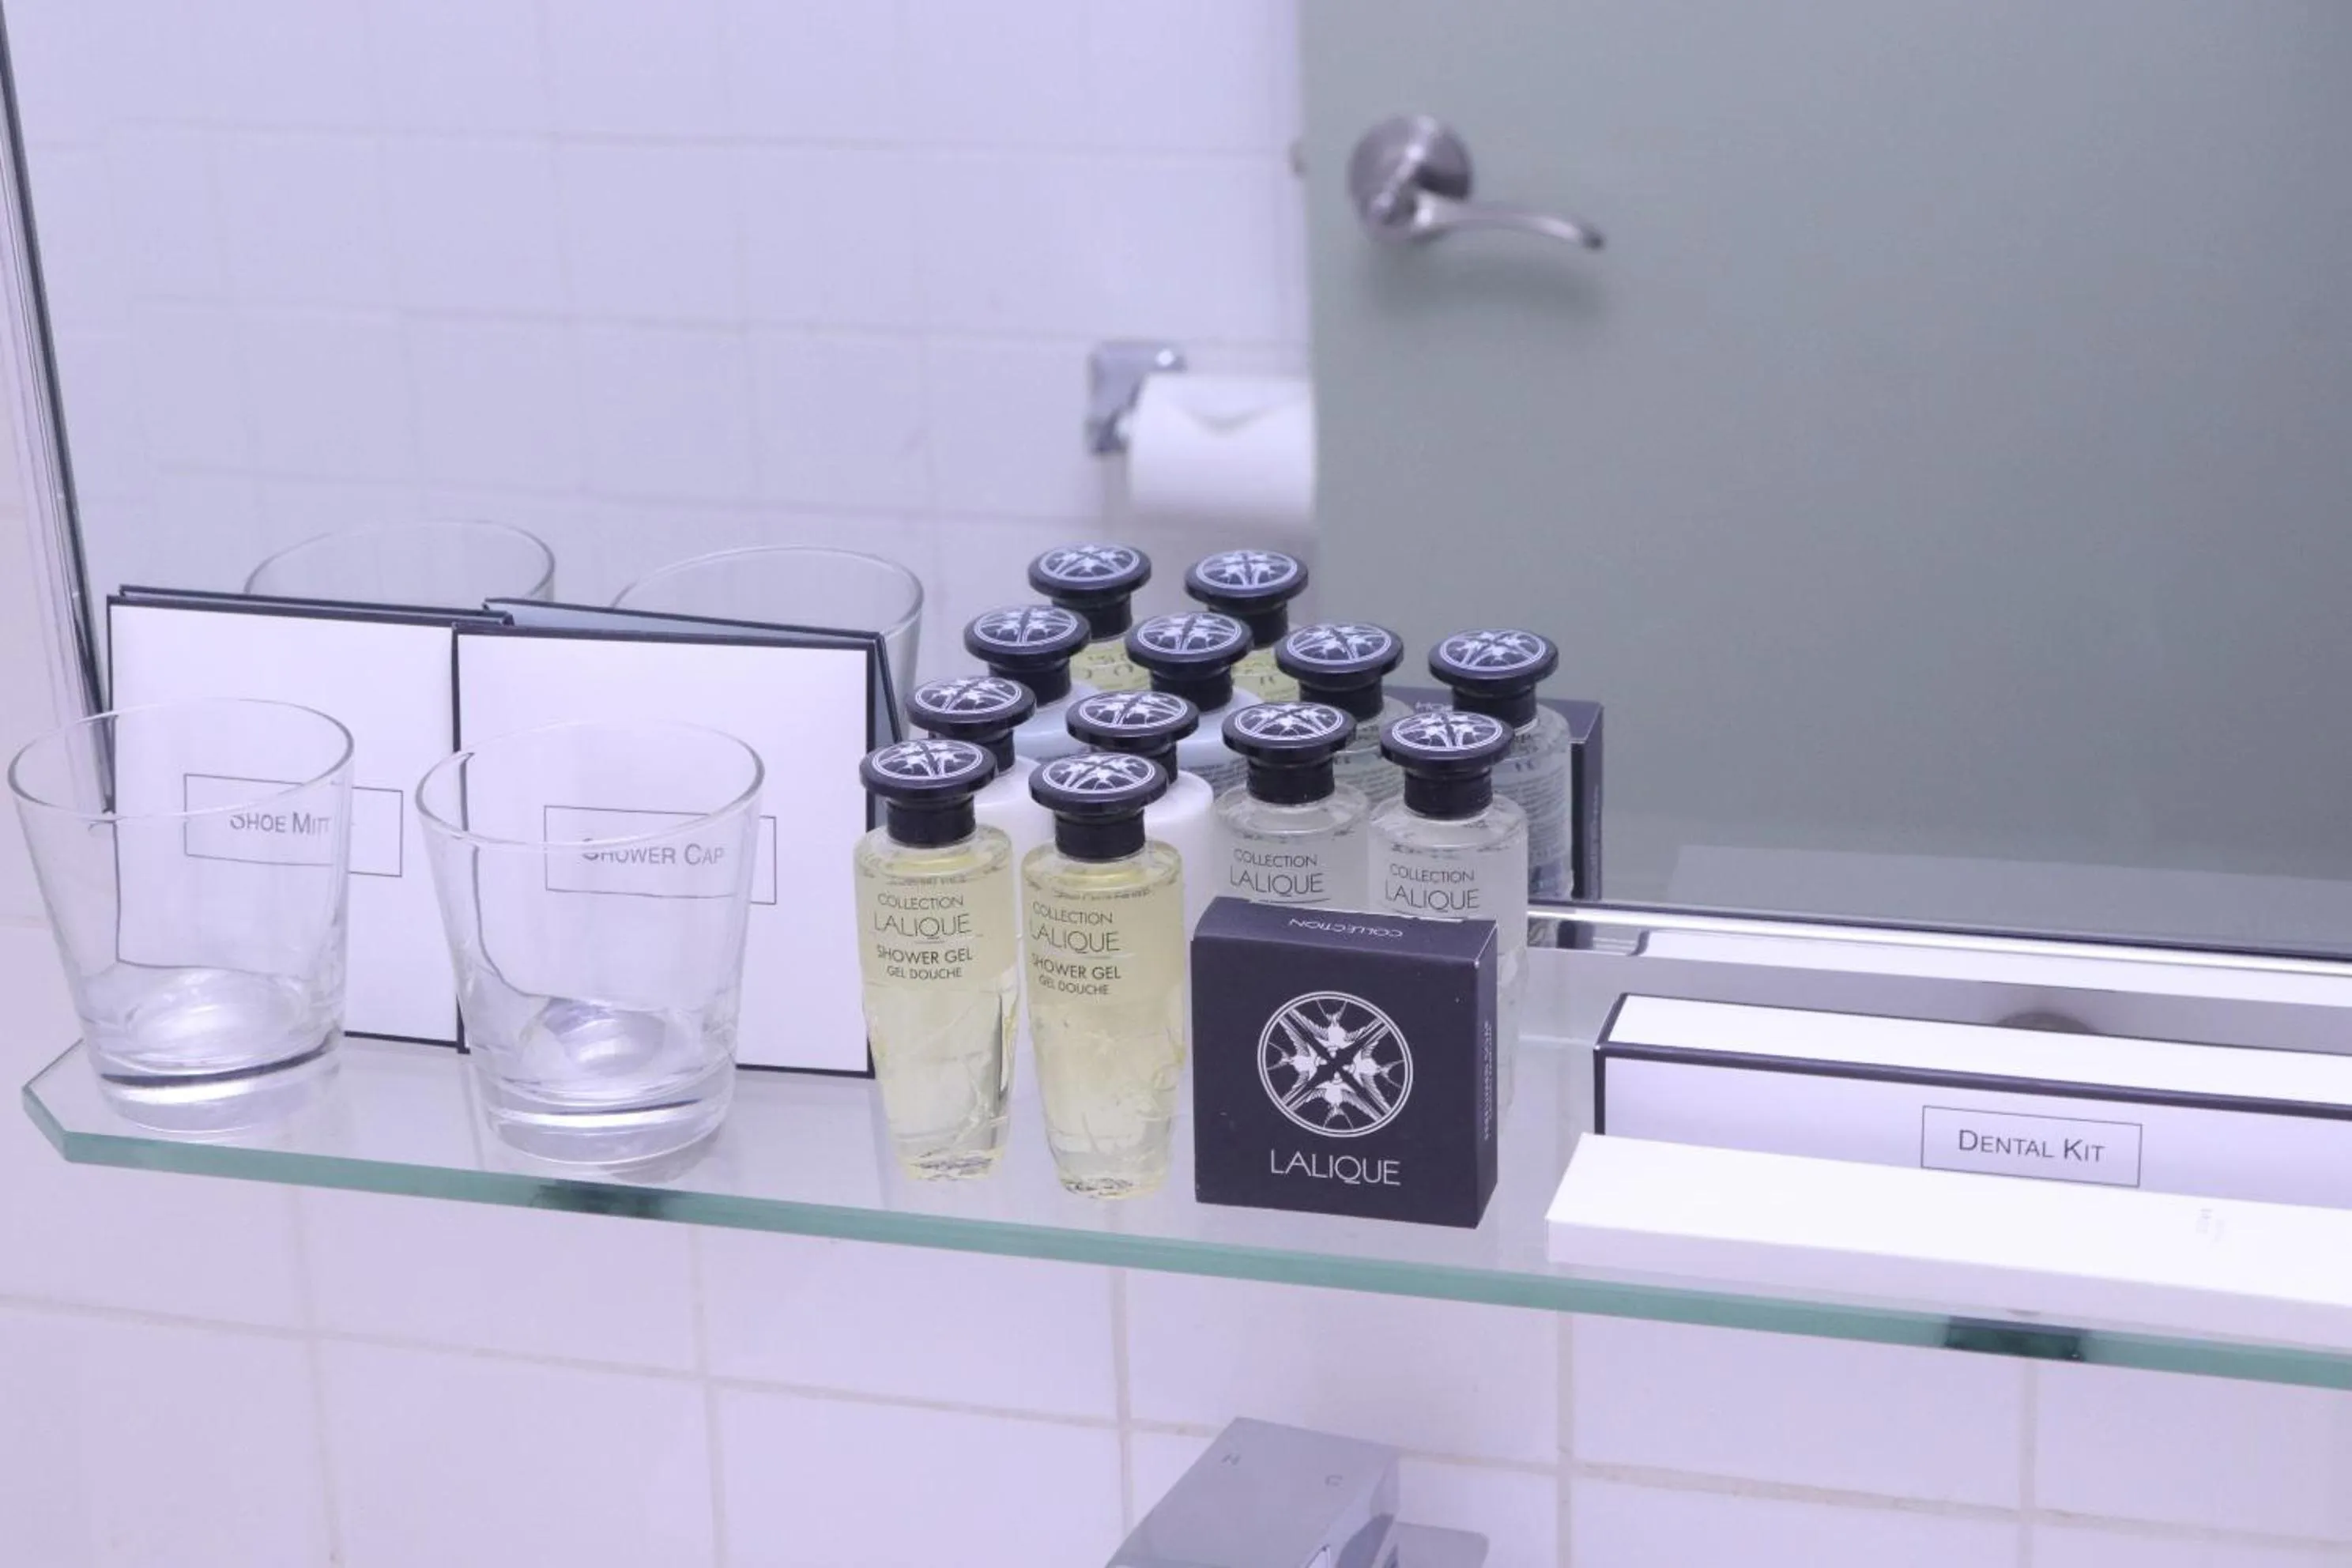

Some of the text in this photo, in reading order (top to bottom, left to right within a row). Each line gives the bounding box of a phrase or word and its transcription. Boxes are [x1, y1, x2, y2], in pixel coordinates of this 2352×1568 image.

[684, 842, 726, 866] CAP
[1234, 848, 1318, 869] COLLECTION
[1230, 865, 1325, 898] LALIQUE
[1389, 863, 1476, 884] COLLECTION
[877, 891, 964, 910] COLLECTION
[1385, 878, 1481, 914] LALIQUE
[1032, 901, 1114, 925] COLLECTION
[873, 913, 972, 940] LALIQUE
[1030, 921, 1122, 955] LALIQUE
[1287, 917, 1404, 938] COLLECTION
[876, 944, 974, 966] SHOWER GEL
[1031, 953, 1122, 981] SHOWER GEL
[886, 965, 963, 980] GEL DOUCHE
[1038, 974, 1110, 996] GEL DOUCHE
[1957, 1129, 2106, 1163] DENTAL KIT
[1269, 1148, 1402, 1186] LALIQUE
